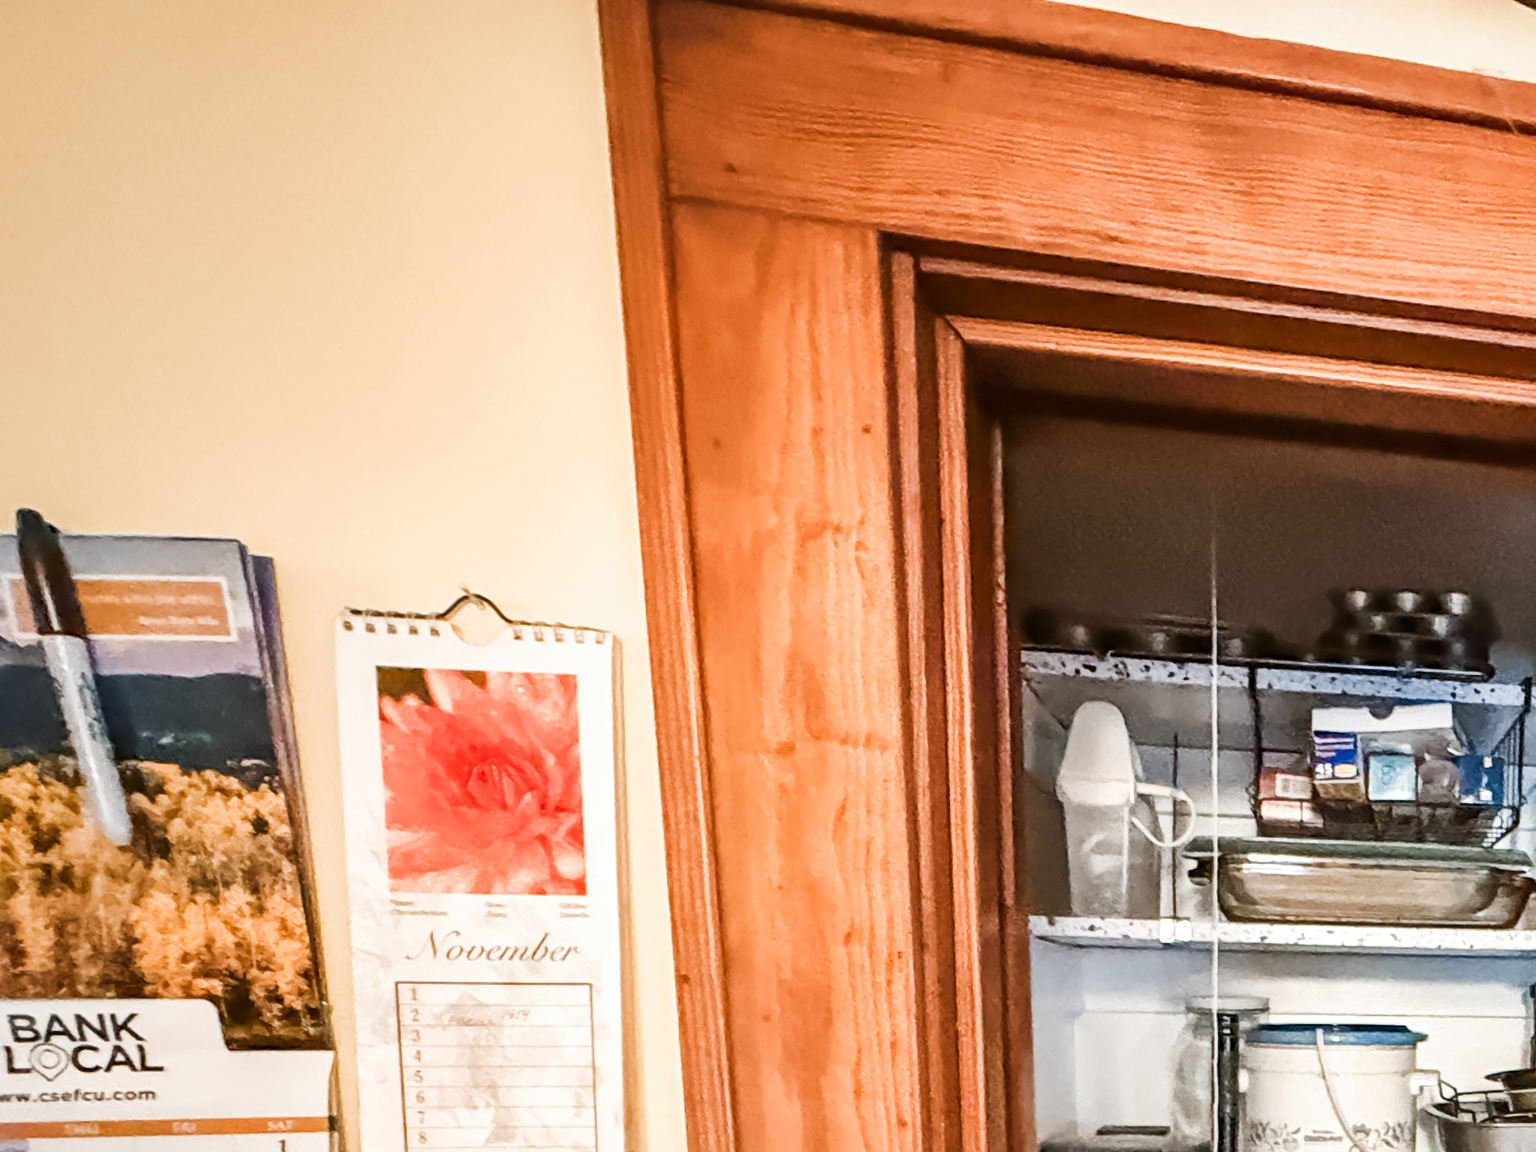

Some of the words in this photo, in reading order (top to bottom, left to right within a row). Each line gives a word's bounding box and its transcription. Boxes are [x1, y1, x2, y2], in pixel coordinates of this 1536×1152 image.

[405, 930, 581, 963] November
[7, 1012, 148, 1043] BANK
[4, 1043, 165, 1081] LOCAL
[267, 1119, 296, 1132] SAT
